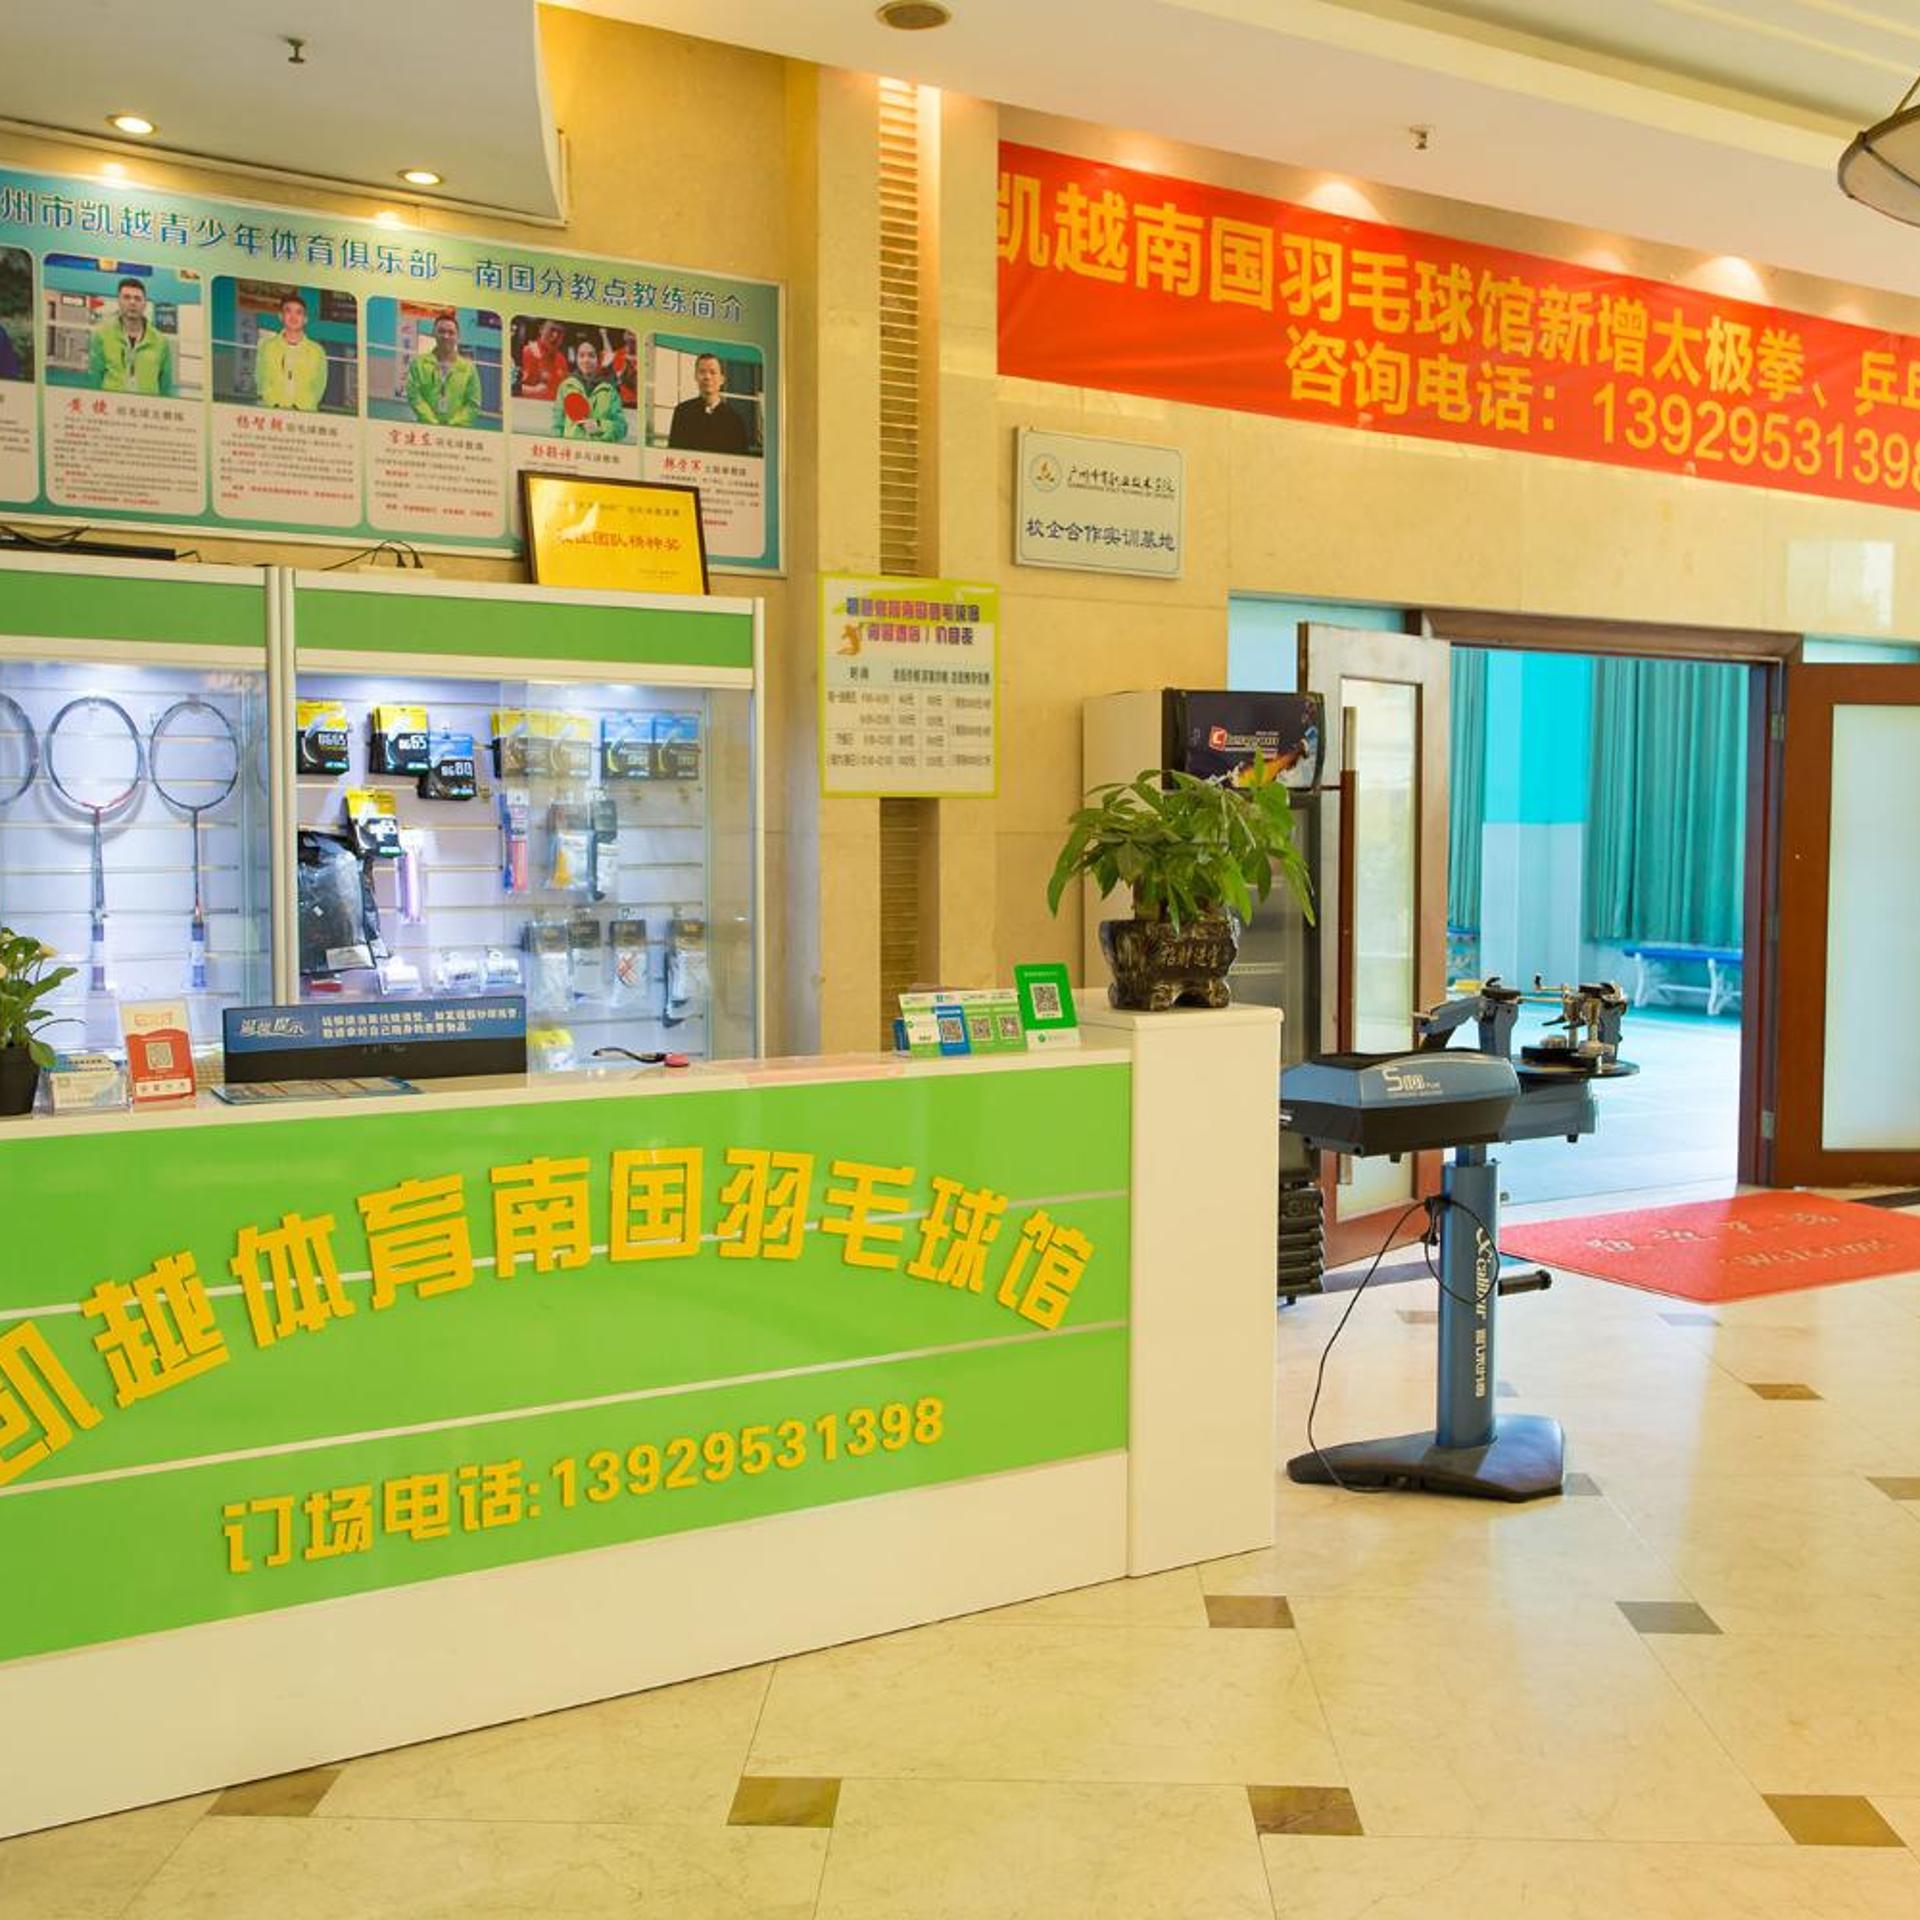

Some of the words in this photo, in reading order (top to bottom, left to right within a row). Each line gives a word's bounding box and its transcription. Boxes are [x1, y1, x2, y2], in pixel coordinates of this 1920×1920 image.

[1026, 517, 1176, 552] 校企合作实训基地
[0, 1147, 1096, 1485] 凯越体育南国羽毛球馆
[223, 1397, 946, 1575] 订场电话:13929531398
